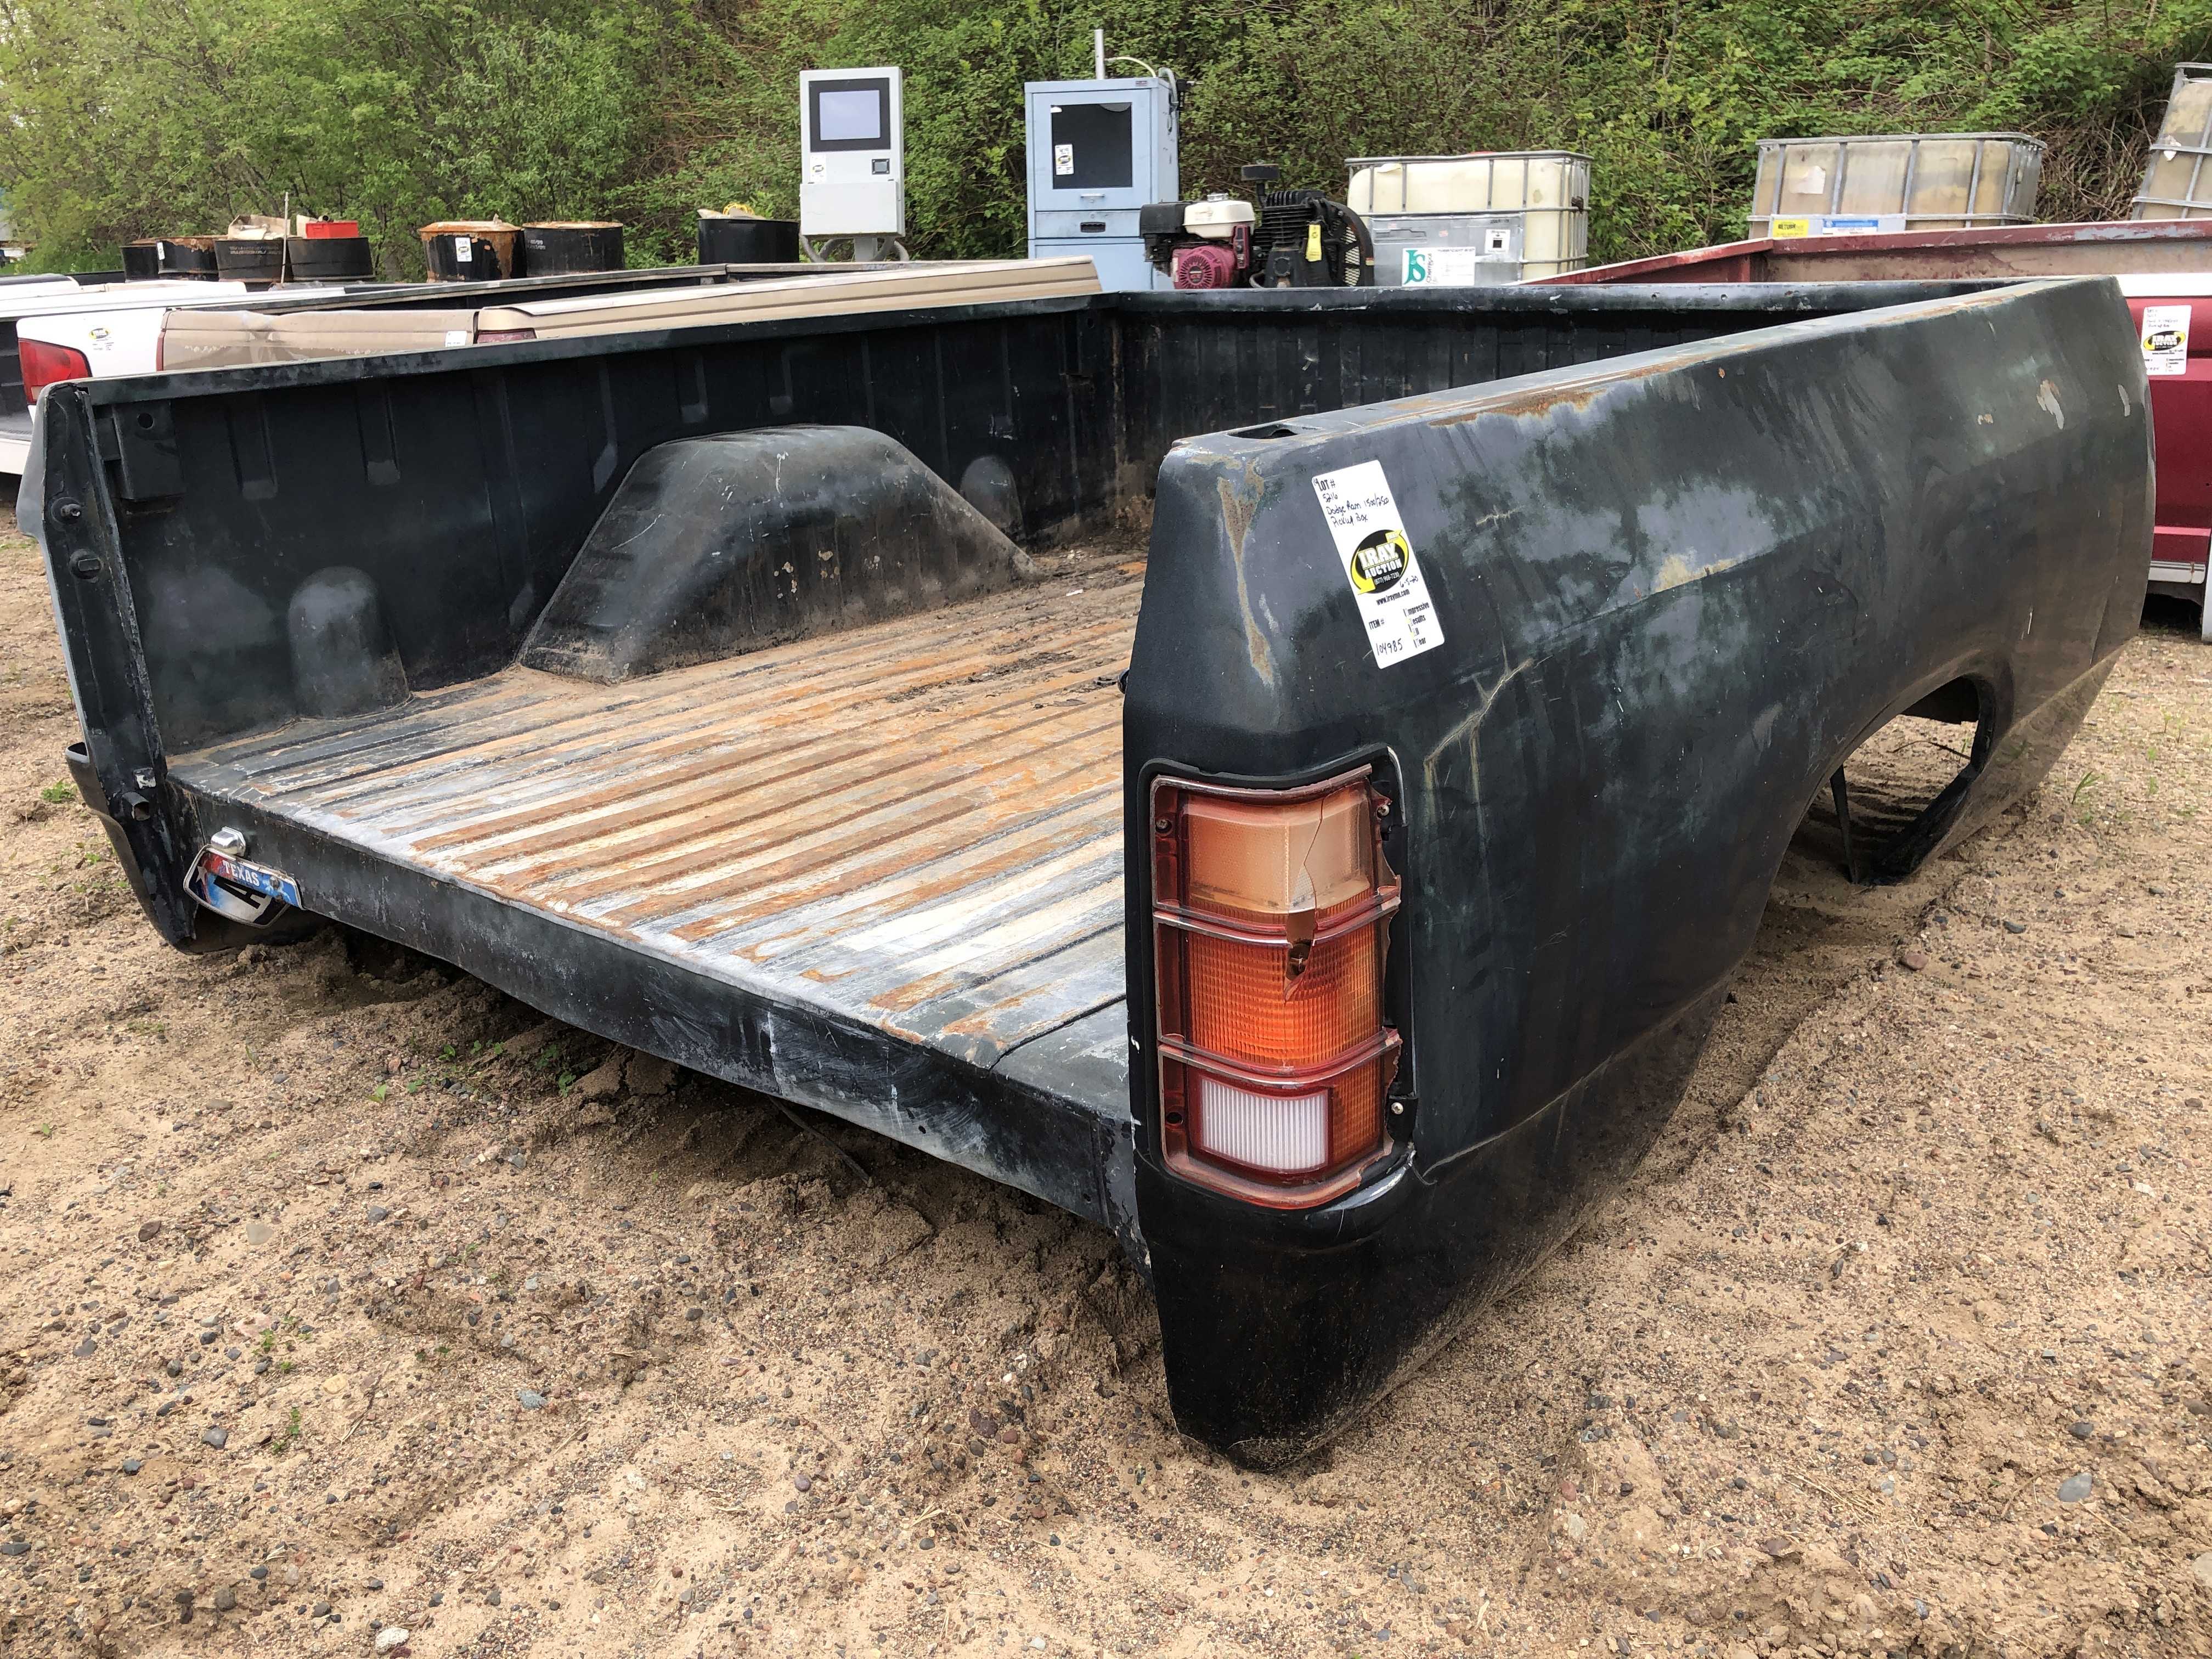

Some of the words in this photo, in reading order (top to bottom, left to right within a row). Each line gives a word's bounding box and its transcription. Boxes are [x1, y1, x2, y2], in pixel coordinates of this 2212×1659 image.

[1317, 479, 1329, 492] LOT
[1326, 505, 1346, 516] Dodge
[1347, 500, 1361, 510] Ram
[1364, 493, 1389, 507] 1500/2500
[1331, 516, 1354, 527] Pickup
[1356, 513, 1368, 522] Box
[1364, 558, 1402, 579] AUCTION
[1369, 619, 1380, 630] ITEM
[1376, 637, 1403, 656] 104985
[222, 859, 259, 887] TEXAS
